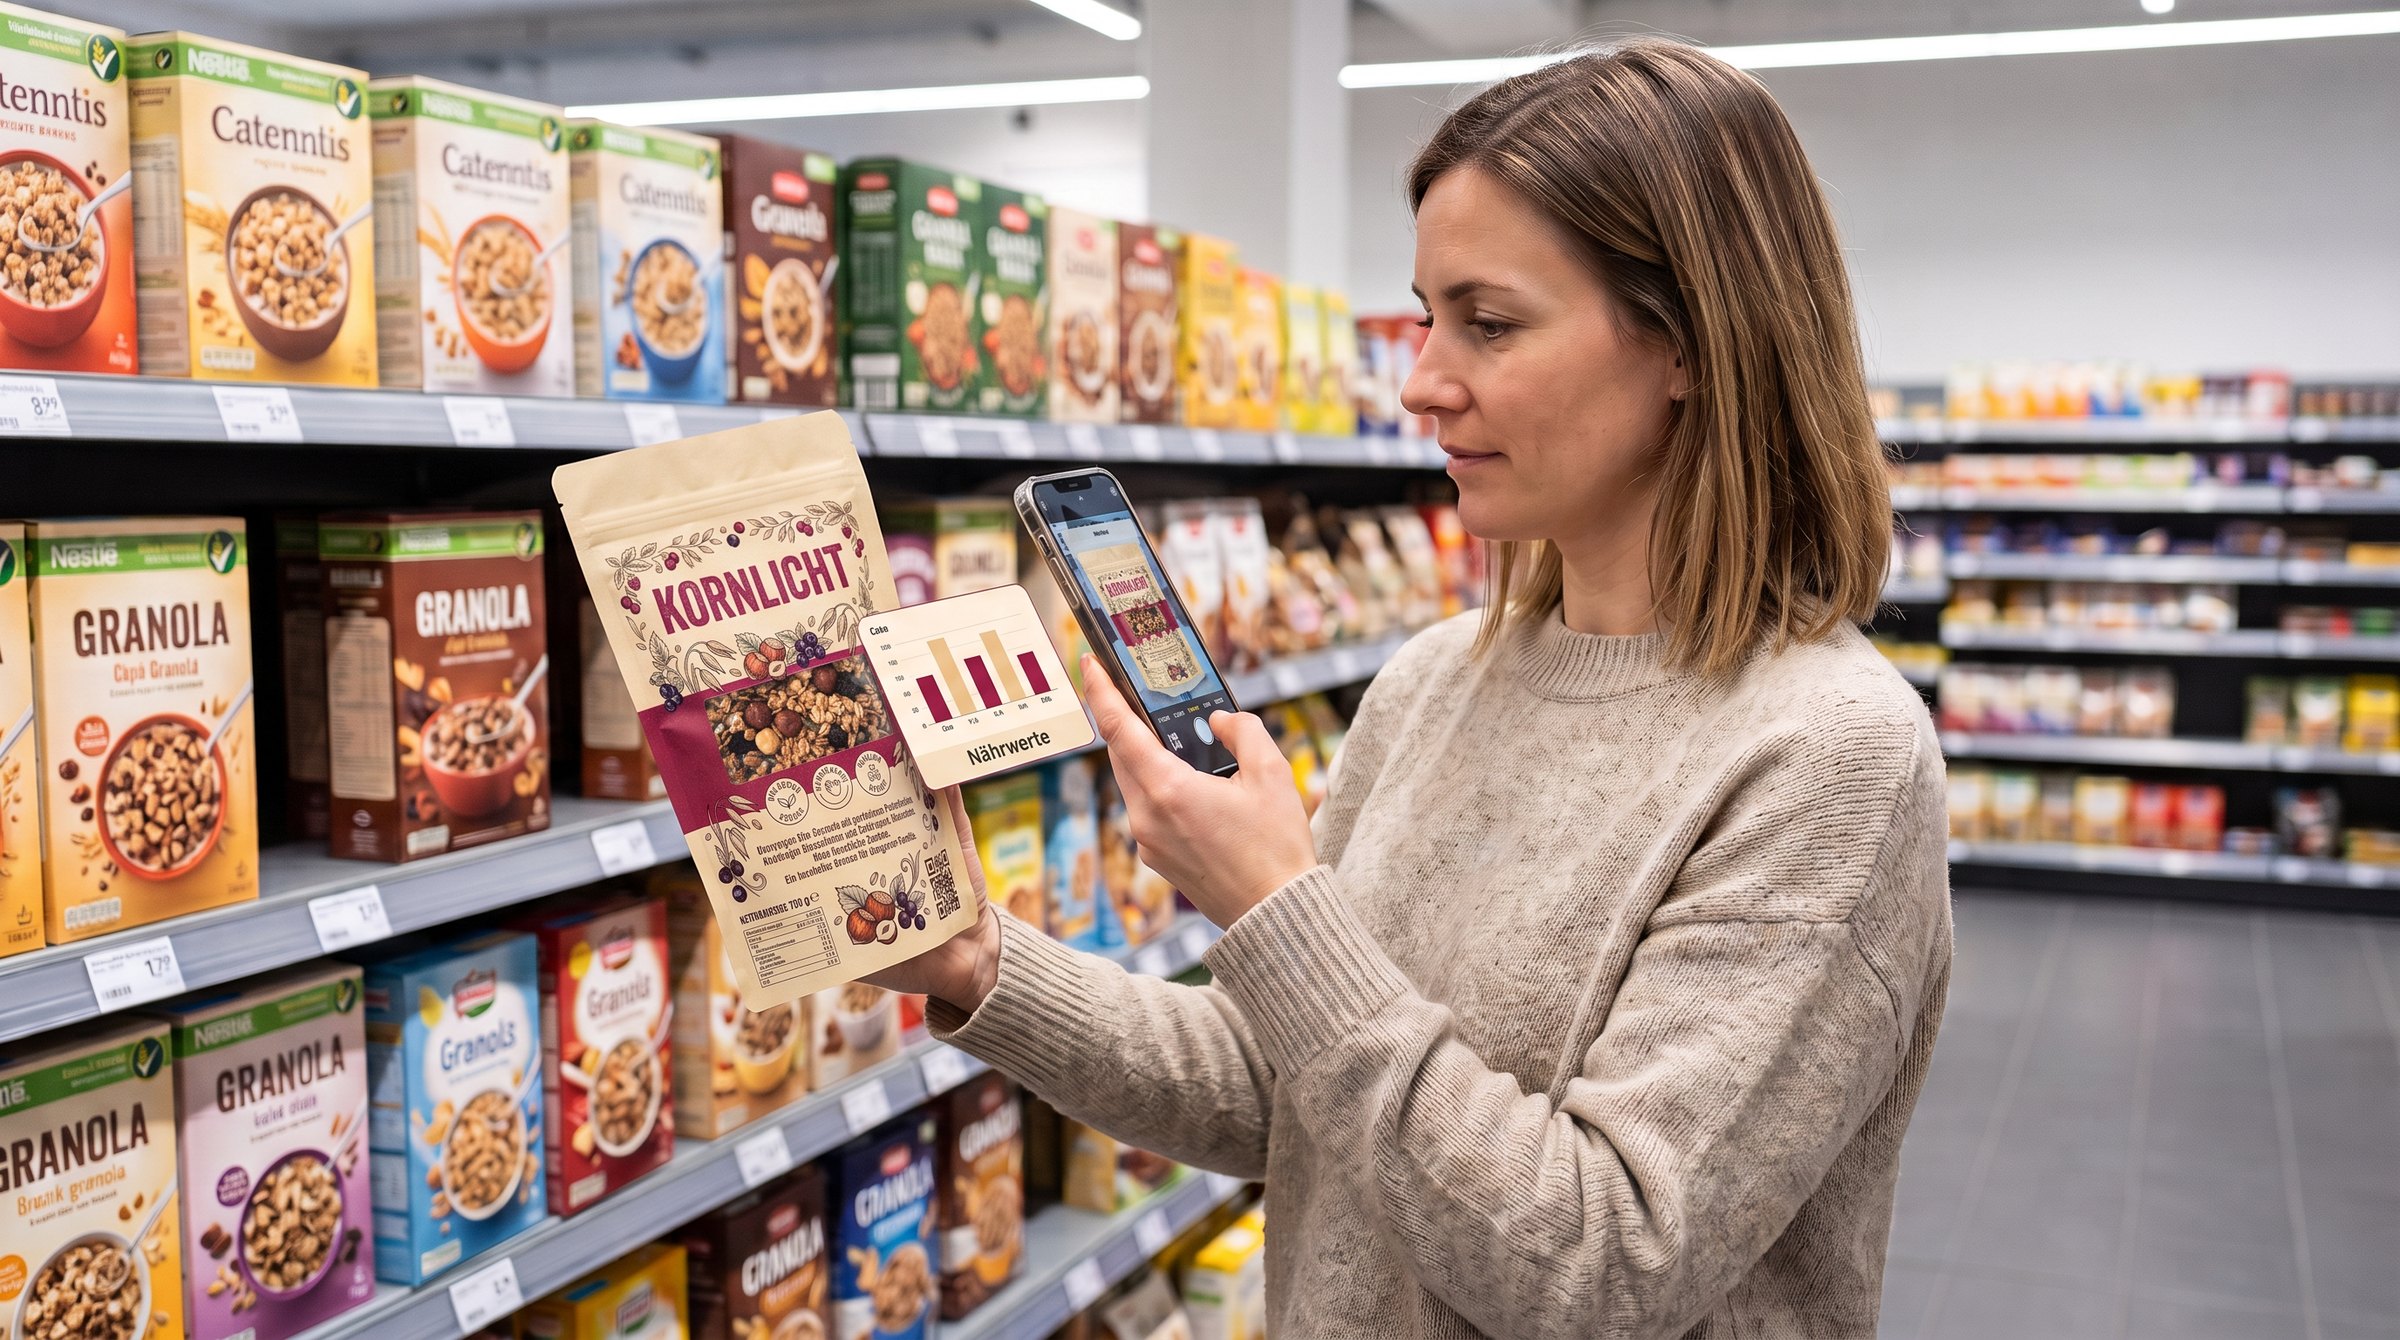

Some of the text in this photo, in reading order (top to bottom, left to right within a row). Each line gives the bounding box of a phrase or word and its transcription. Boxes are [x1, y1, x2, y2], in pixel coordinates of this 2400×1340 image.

[211, 105, 350, 163] Catenntis
[415, 584, 532, 638] GRANOLA
[652, 542, 850, 635] KORNLICHT
[73, 601, 230, 658] GRANOLA
[966, 731, 1051, 766] Nährwerte
[216, 1033, 346, 1113] GRANOLA
[741, 1215, 824, 1297] GRANOLA
